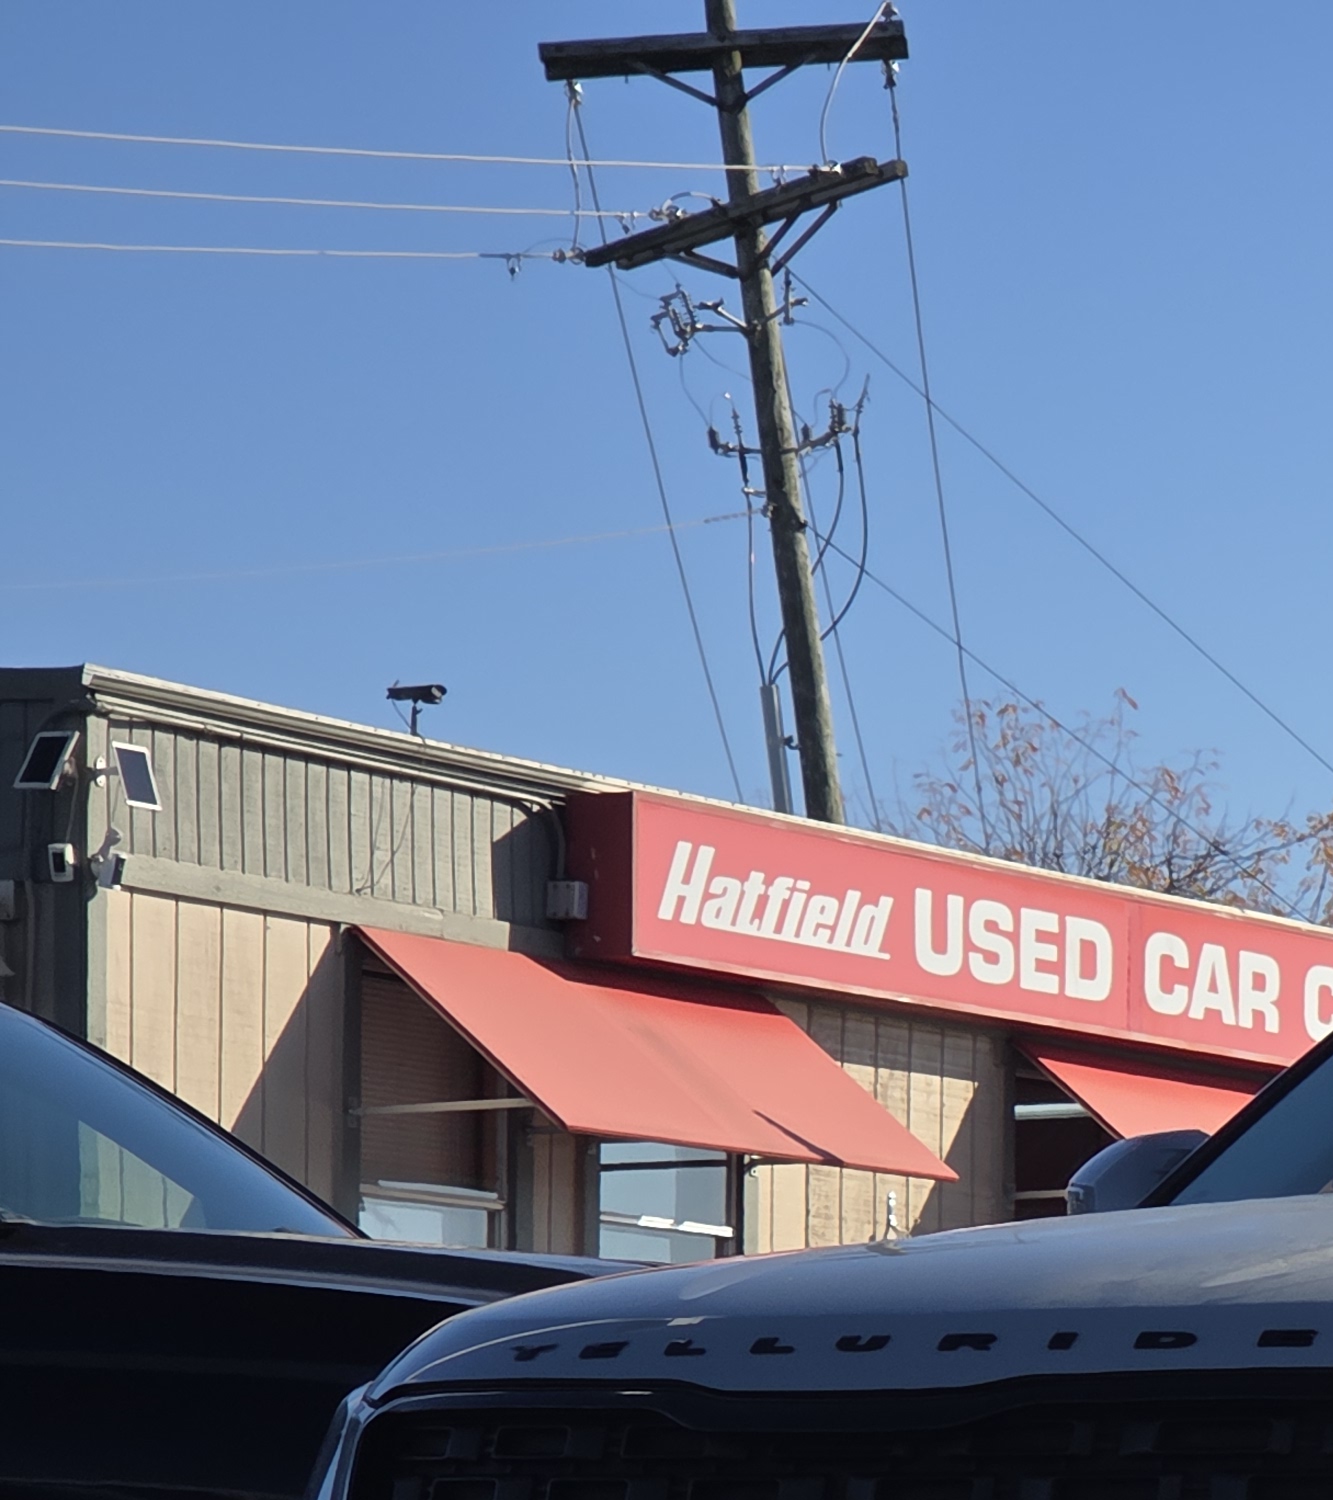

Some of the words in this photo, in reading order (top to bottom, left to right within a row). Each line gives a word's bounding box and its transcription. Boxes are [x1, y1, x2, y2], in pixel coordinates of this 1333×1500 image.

[657, 841, 893, 960] Hatfield
[914, 887, 1112, 1002] USED
[1143, 931, 1281, 1034] CAR
[509, 1328, 1320, 1360] TELLURIDE
